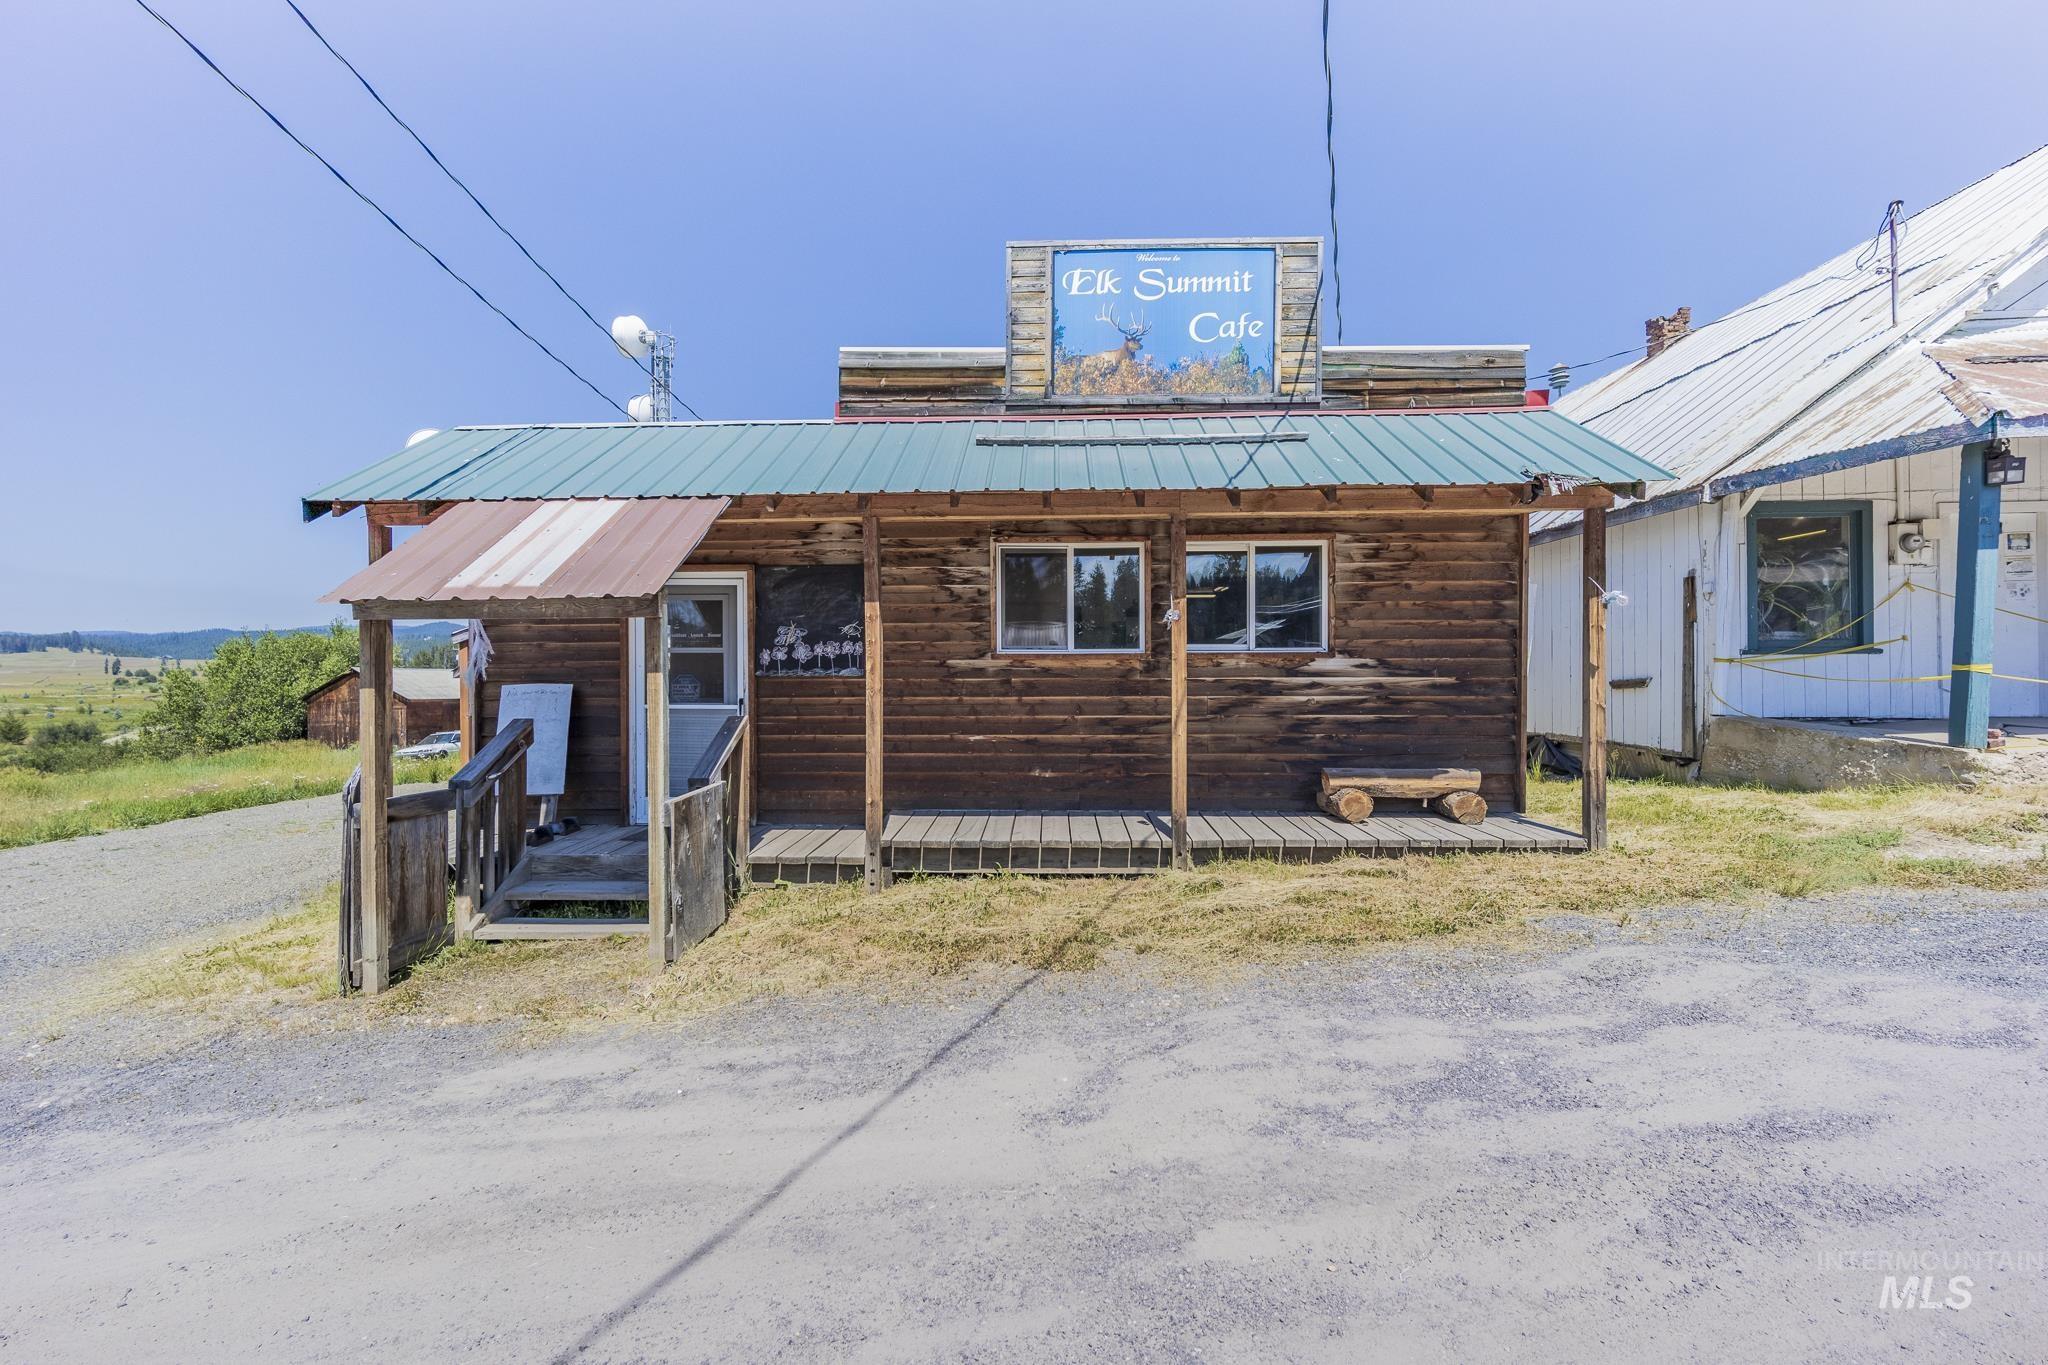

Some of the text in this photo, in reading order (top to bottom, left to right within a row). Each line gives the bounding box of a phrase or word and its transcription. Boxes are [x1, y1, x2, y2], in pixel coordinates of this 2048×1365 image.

[1136, 252, 1181, 262] Welcome to
[1062, 268, 1254, 301] Elk Summit
[1189, 312, 1264, 343] Cafe
